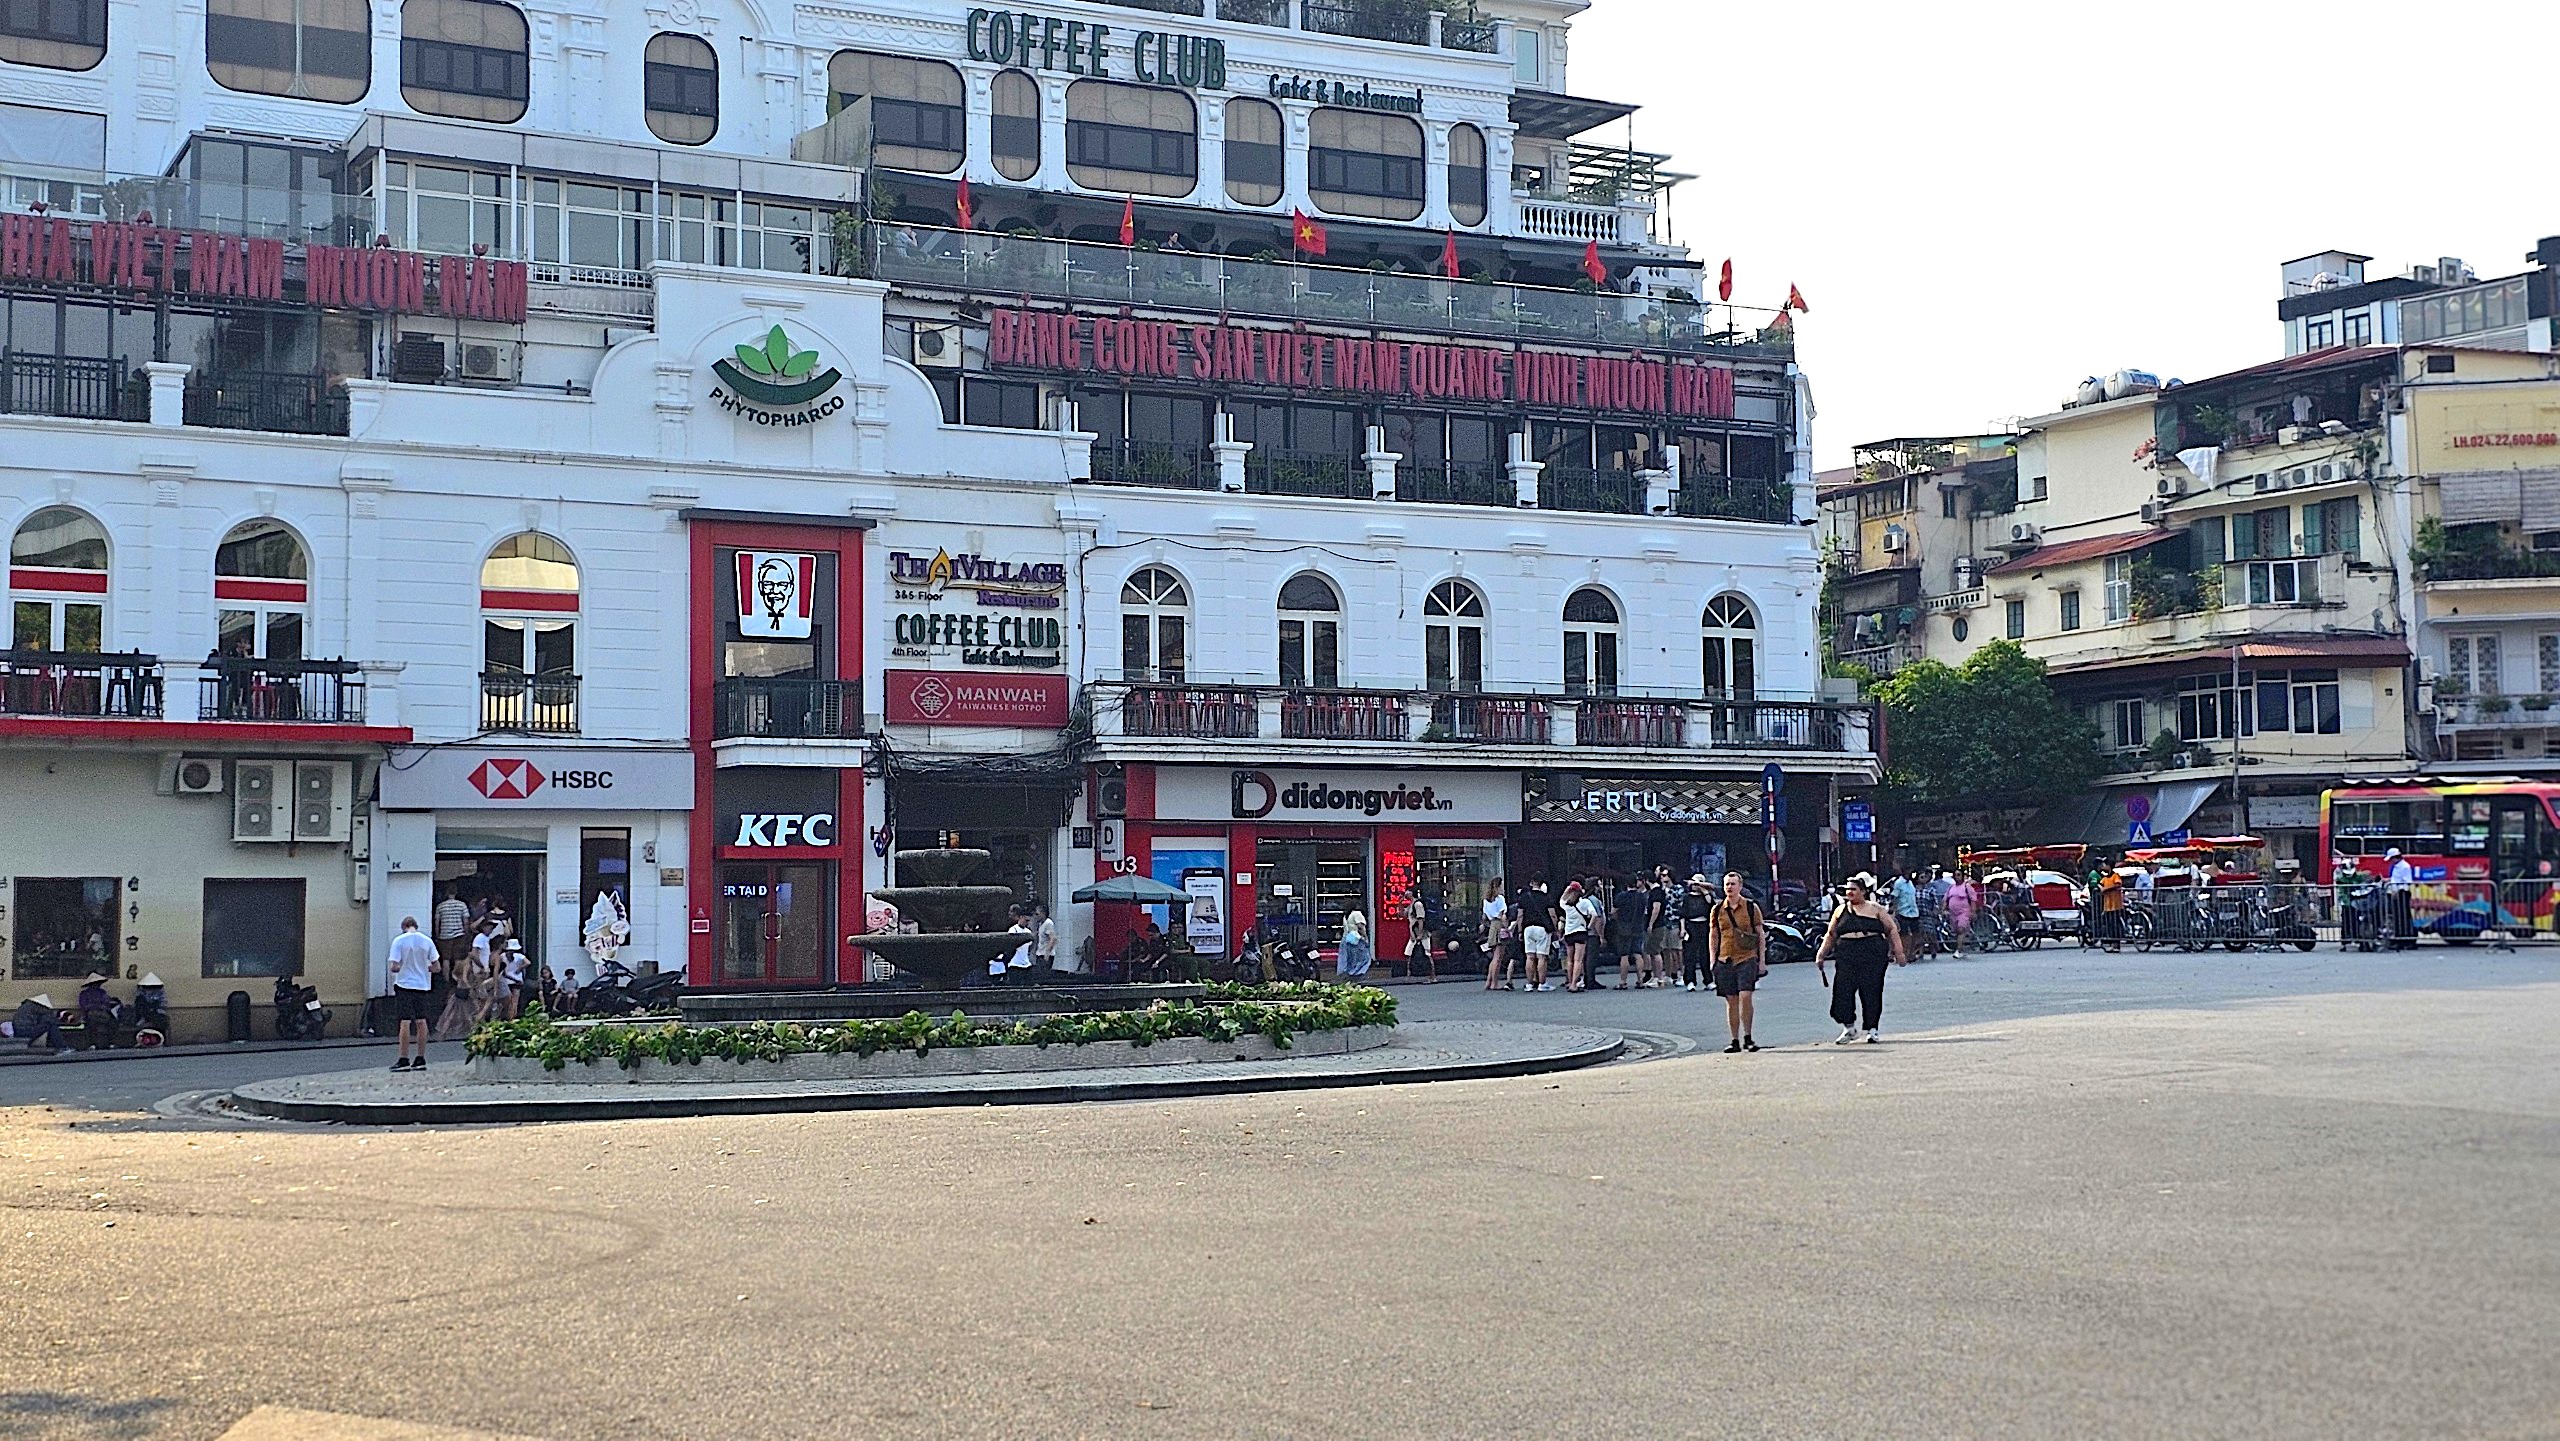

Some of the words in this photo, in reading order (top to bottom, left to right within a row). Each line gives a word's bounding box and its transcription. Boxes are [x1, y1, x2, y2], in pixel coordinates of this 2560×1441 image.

[968, 8, 1111, 78] COFFEE
[1135, 30, 1226, 90] CLUB
[1269, 73, 1312, 100] Café
[1316, 78, 1329, 103] &
[1334, 81, 1424, 114] Restaurant
[190, 232, 285, 300] NAM
[306, 233, 425, 313] MUÔN
[440, 242, 528, 324] NĂM
[991, 292, 1081, 371] ĐẢNG
[1193, 311, 1255, 382] SẢN
[1263, 321, 1326, 396] VIỆT
[1334, 337, 1400, 395] NAM
[1407, 342, 1504, 401] QUANG
[1513, 350, 1579, 407] VINH
[1586, 347, 1666, 413] MUÔN
[1671, 353, 1734, 420] NĂM
[709, 386, 845, 428] PHYTOPHARCO
[918, 590, 944, 601] Floor
[977, 590, 1060, 608] Restaurants
[896, 613, 989, 646] COFFEE
[999, 615, 1061, 648] CLUB
[892, 647, 905, 657] 4th
[907, 647, 928, 657] Floor
[962, 648, 988, 665] Café
[989, 648, 1001, 665] &
[1002, 650, 1061, 669] Restaurant
[918, 681, 945, 714] 文華
[957, 686, 1047, 703] MANWAH
[957, 702, 1010, 711] TAIWANESE
[1011, 703, 1047, 712] HOTPOT
[551, 770, 613, 789] HSBC
[1281, 782, 1453, 817] didongviet.vn
[1659, 811, 1670, 821] by
[735, 813, 833, 847] KFC
